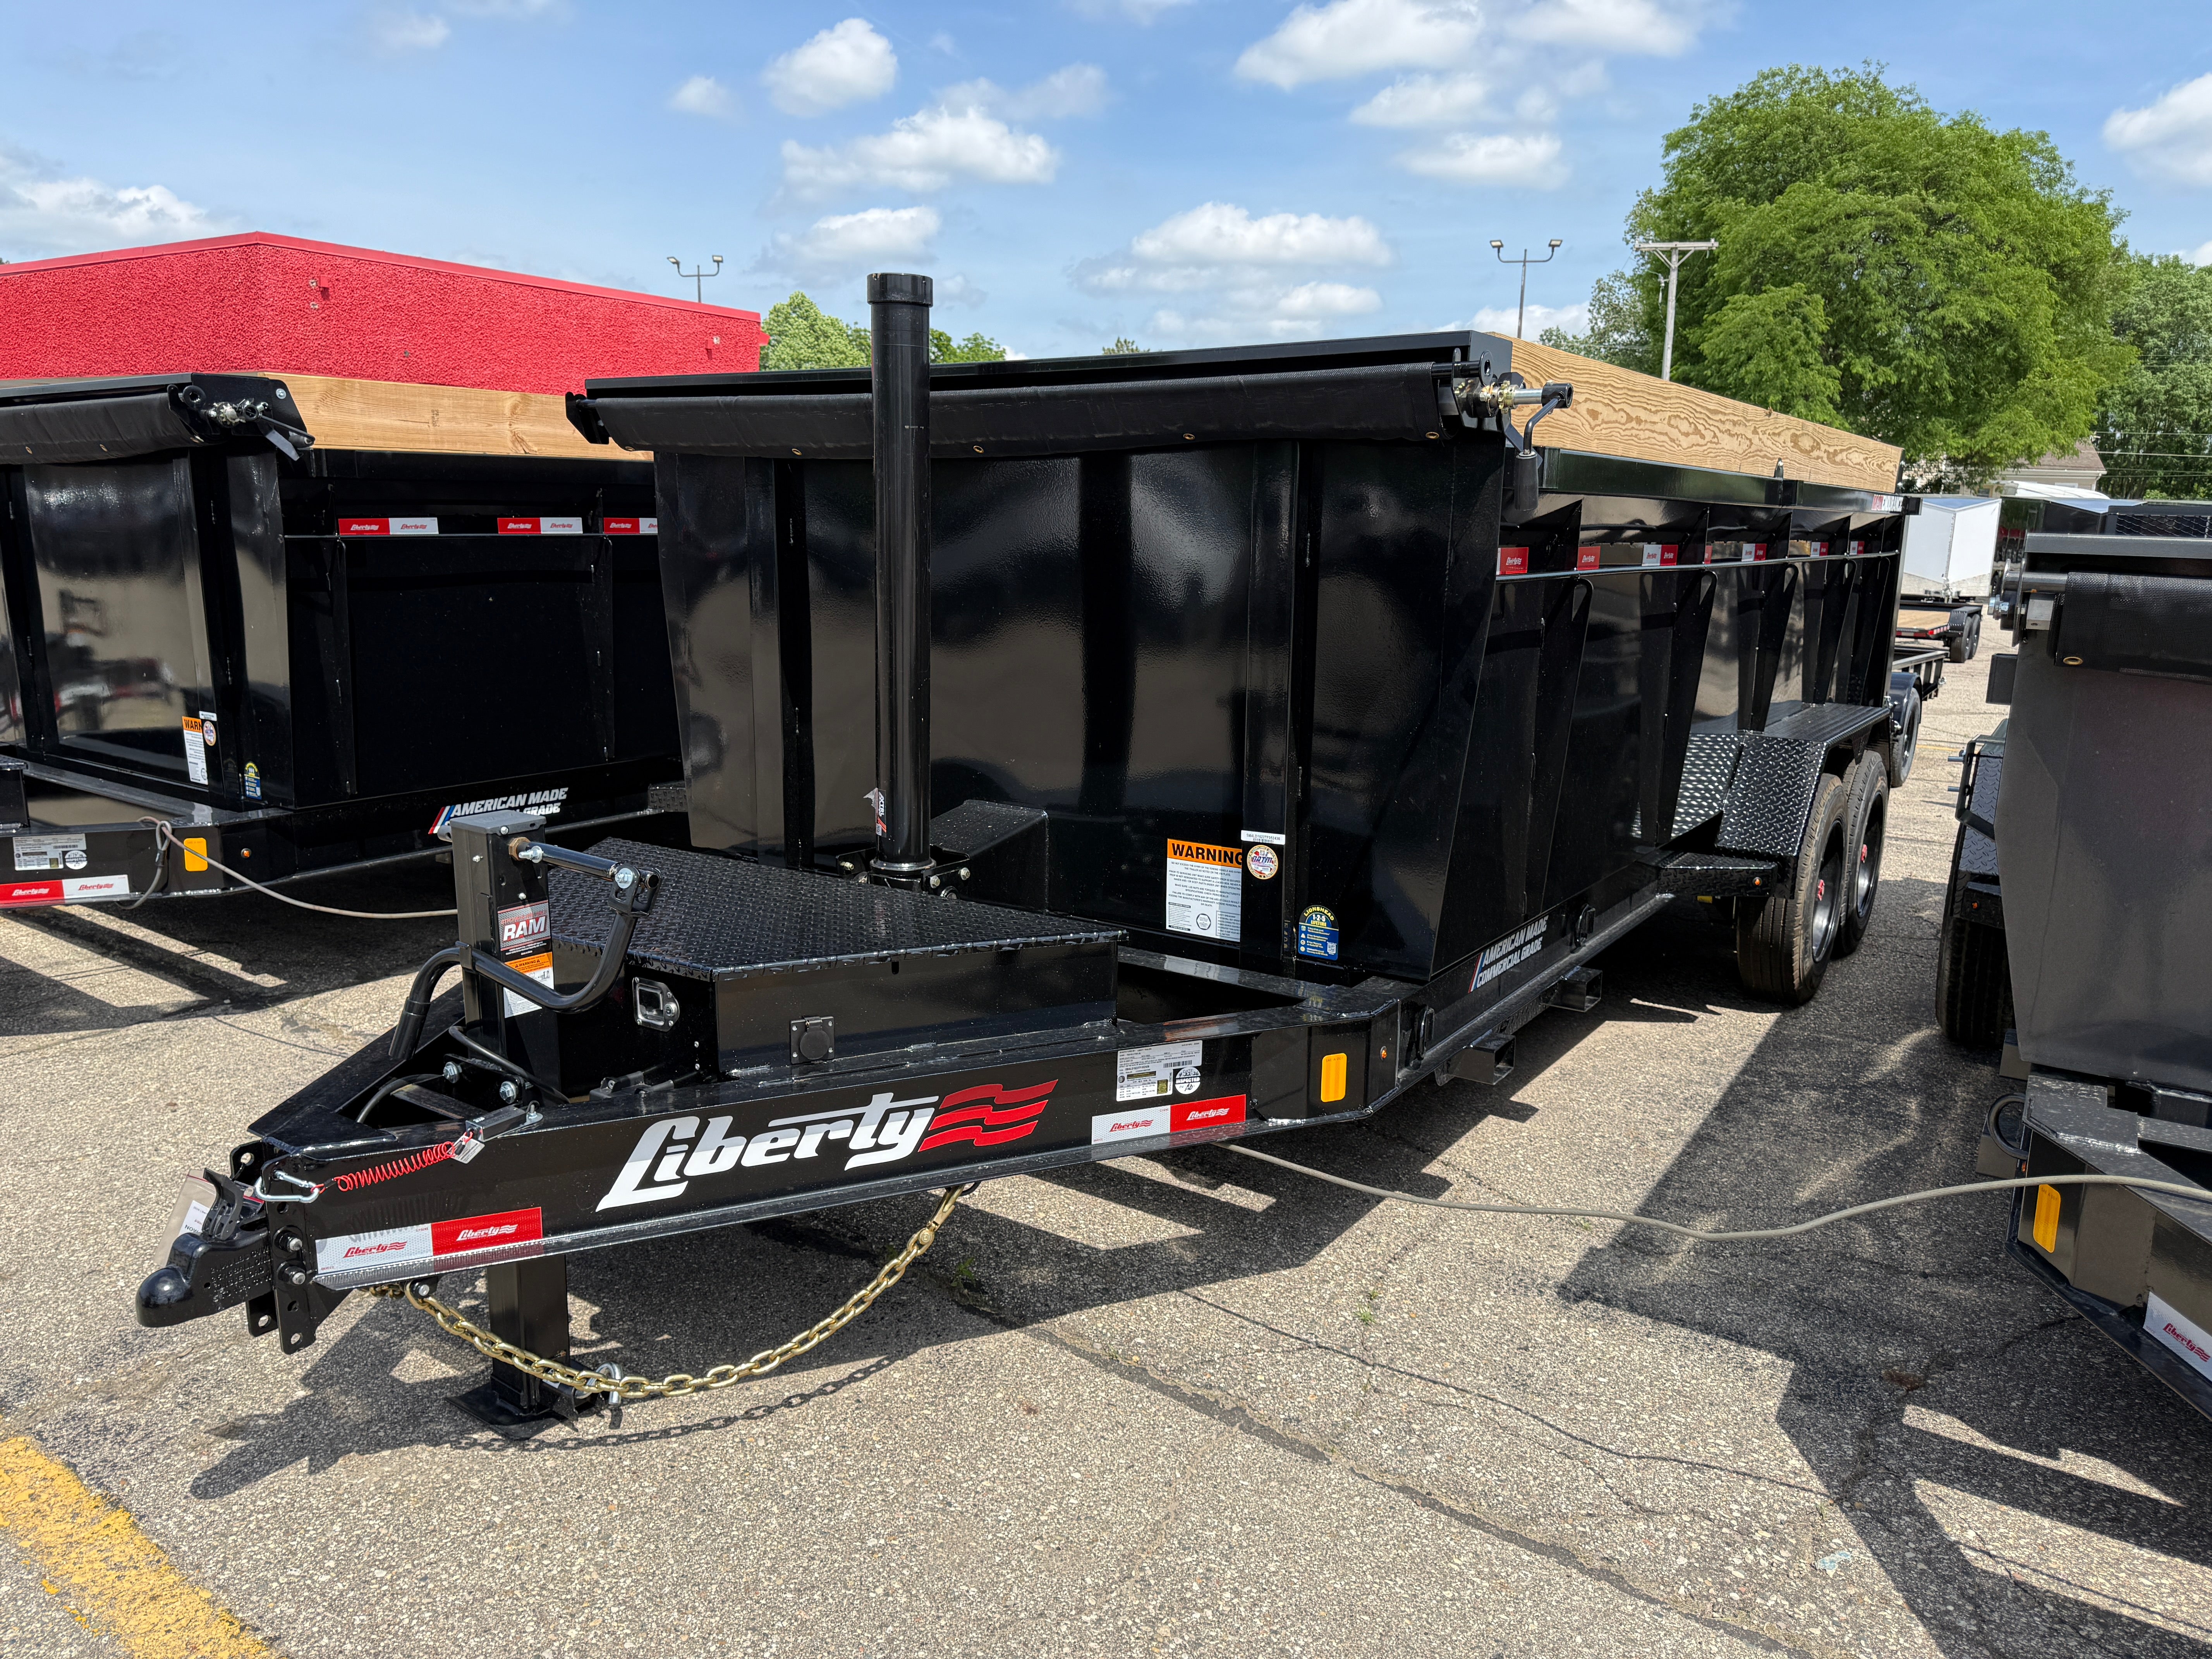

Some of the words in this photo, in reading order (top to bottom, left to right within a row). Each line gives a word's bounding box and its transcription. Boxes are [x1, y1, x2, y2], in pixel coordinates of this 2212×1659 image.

[450, 794, 527, 817] AMERICAN
[528, 788, 568, 805] MADE
[1172, 843, 1242, 865] WARNING
[1304, 907, 1334, 921] LIONSHEAD
[503, 916, 545, 941] RAM
[1482, 927, 1525, 967] AMERICAN
[1525, 915, 1548, 942] MADE
[1477, 952, 1522, 988] COMMERCIAL
[1521, 936, 1543, 961] GRADE
[1109, 1121, 1139, 1132] Liberty
[1187, 1109, 1216, 1121] Liberty
[596, 1092, 939, 1212] Liberty
[456, 1227, 500, 1241] Liberty
[343, 1243, 389, 1258] Liberty
[2163, 1323, 2197, 1352] Liberty
